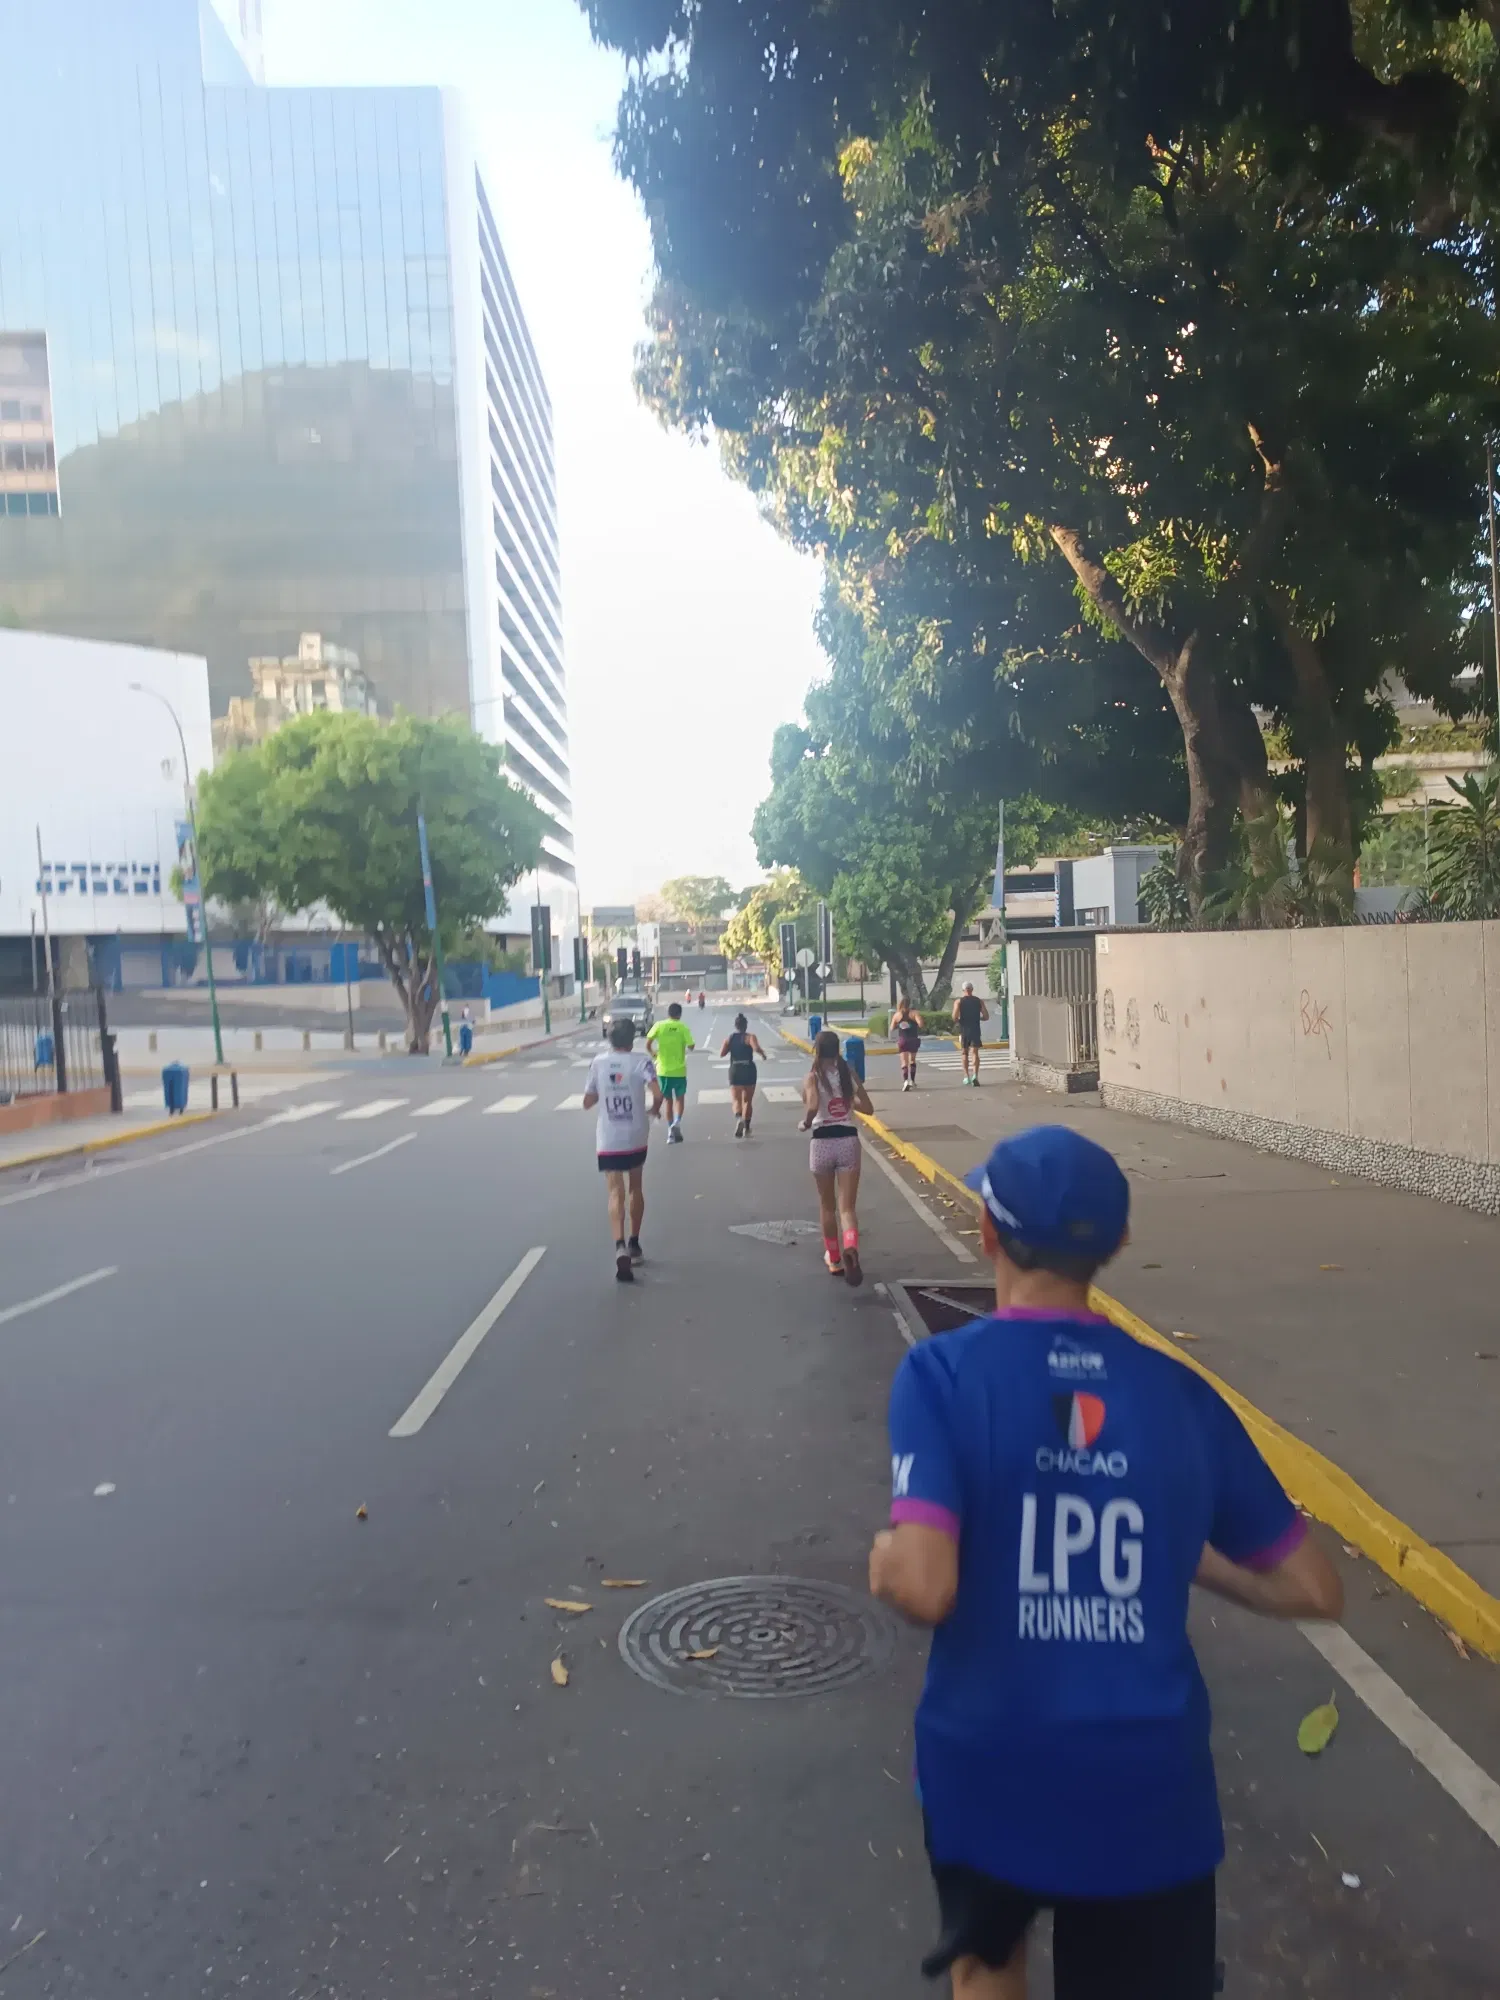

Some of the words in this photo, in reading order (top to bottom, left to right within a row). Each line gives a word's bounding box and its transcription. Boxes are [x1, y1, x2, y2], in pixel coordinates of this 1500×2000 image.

[605, 1096, 633, 1113] LPG
[1035, 1446, 1129, 1479] CHACAO
[1018, 1492, 1145, 1597] LPG
[1018, 1596, 1146, 1644] RUNNERS
